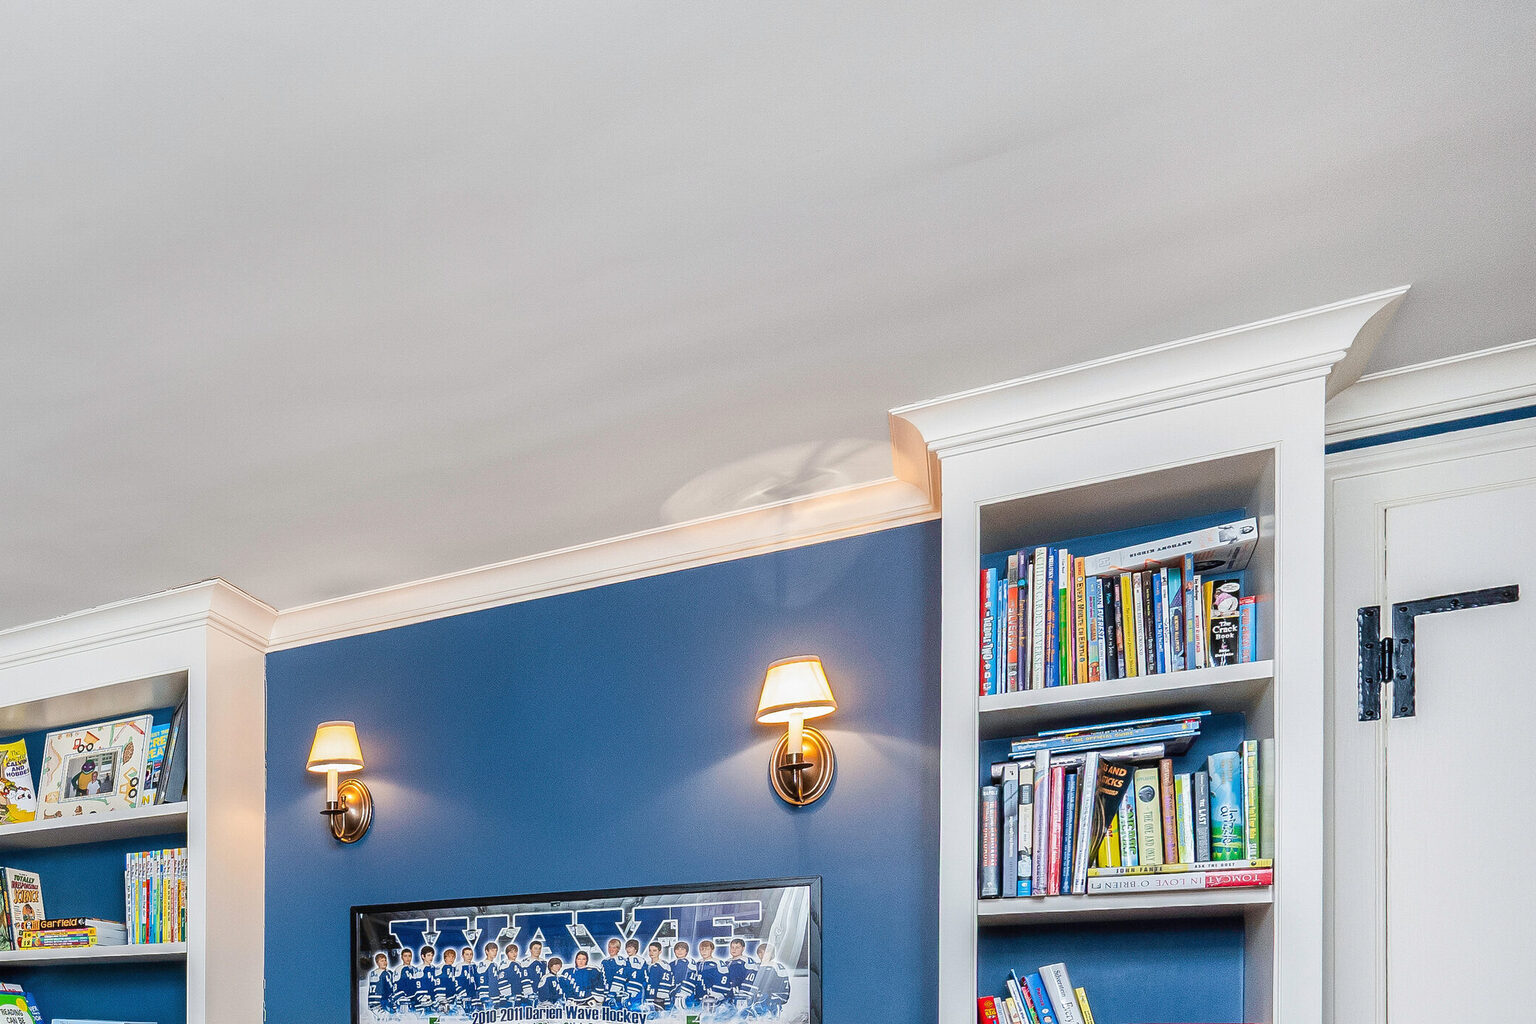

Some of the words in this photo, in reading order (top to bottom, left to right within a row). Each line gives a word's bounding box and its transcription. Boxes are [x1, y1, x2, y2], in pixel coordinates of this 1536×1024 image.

[1034, 591, 1043, 628] GARDEN
[1212, 624, 1238, 634] Crack
[1216, 632, 1234, 640] Book
[1033, 637, 1042, 672] VERSES
[1143, 811, 1153, 822] THE
[1198, 808, 1206, 824] LAST
[1144, 823, 1153, 833] ONE
[1144, 835, 1154, 846] AND
[1145, 847, 1155, 860] ONLY
[14, 875, 34, 883] TOTALLY
[1154, 877, 1184, 886] LOVE
[1190, 876, 1202, 884] IN
[1206, 873, 1258, 885] TOMCAT
[13, 889, 39, 904] SCIENCE
[41, 918, 77, 928] Garfield
[564, 971, 585, 998] DARIEN
[720, 976, 727, 984] 8
[0, 1008, 23, 1016] READING
[526, 1006, 562, 1020] Darien
[566, 1006, 599, 1020] Wave
[1059, 1000, 1078, 1024] Every
